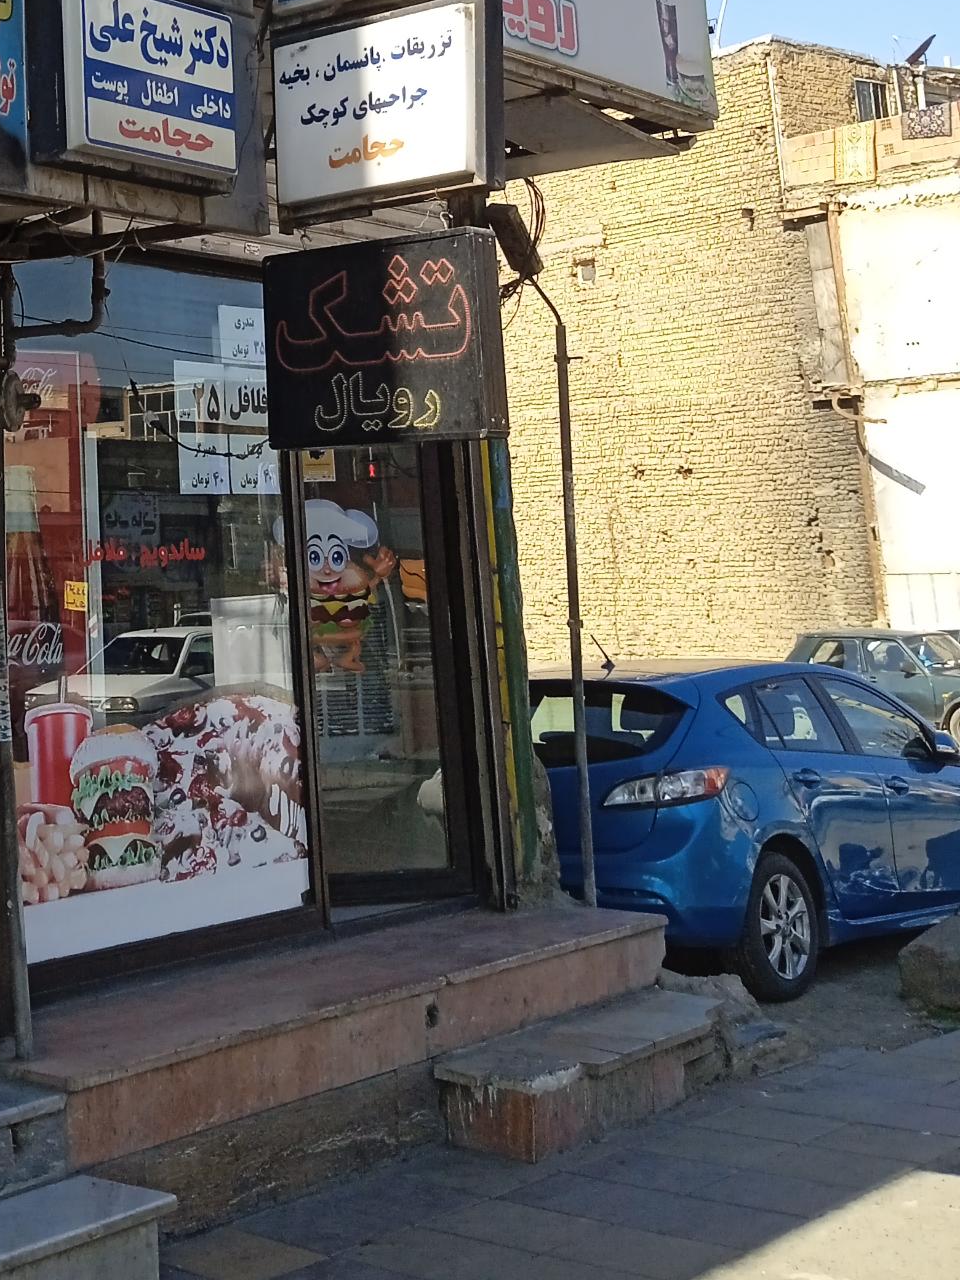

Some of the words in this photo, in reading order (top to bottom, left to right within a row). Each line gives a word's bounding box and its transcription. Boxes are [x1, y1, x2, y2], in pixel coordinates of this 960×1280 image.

[89, 0, 135, 53] علی
[140, 7, 184, 68] شیخ
[185, 26, 230, 75] دکتر
[91, 71, 129, 103] پوست
[141, 79, 179, 108] اطفال
[279, 64, 311, 90] بخیه
[191, 92, 231, 120] داخلی
[300, 96, 349, 129] کوچک
[118, 117, 214, 157] حجامت
[328, 133, 404, 169] حجامت
[275, 255, 471, 372] تشک
[232, 344, 249, 359] تومان
[314, 371, 441, 432] رویال
[191, 472, 210, 489] تومان
